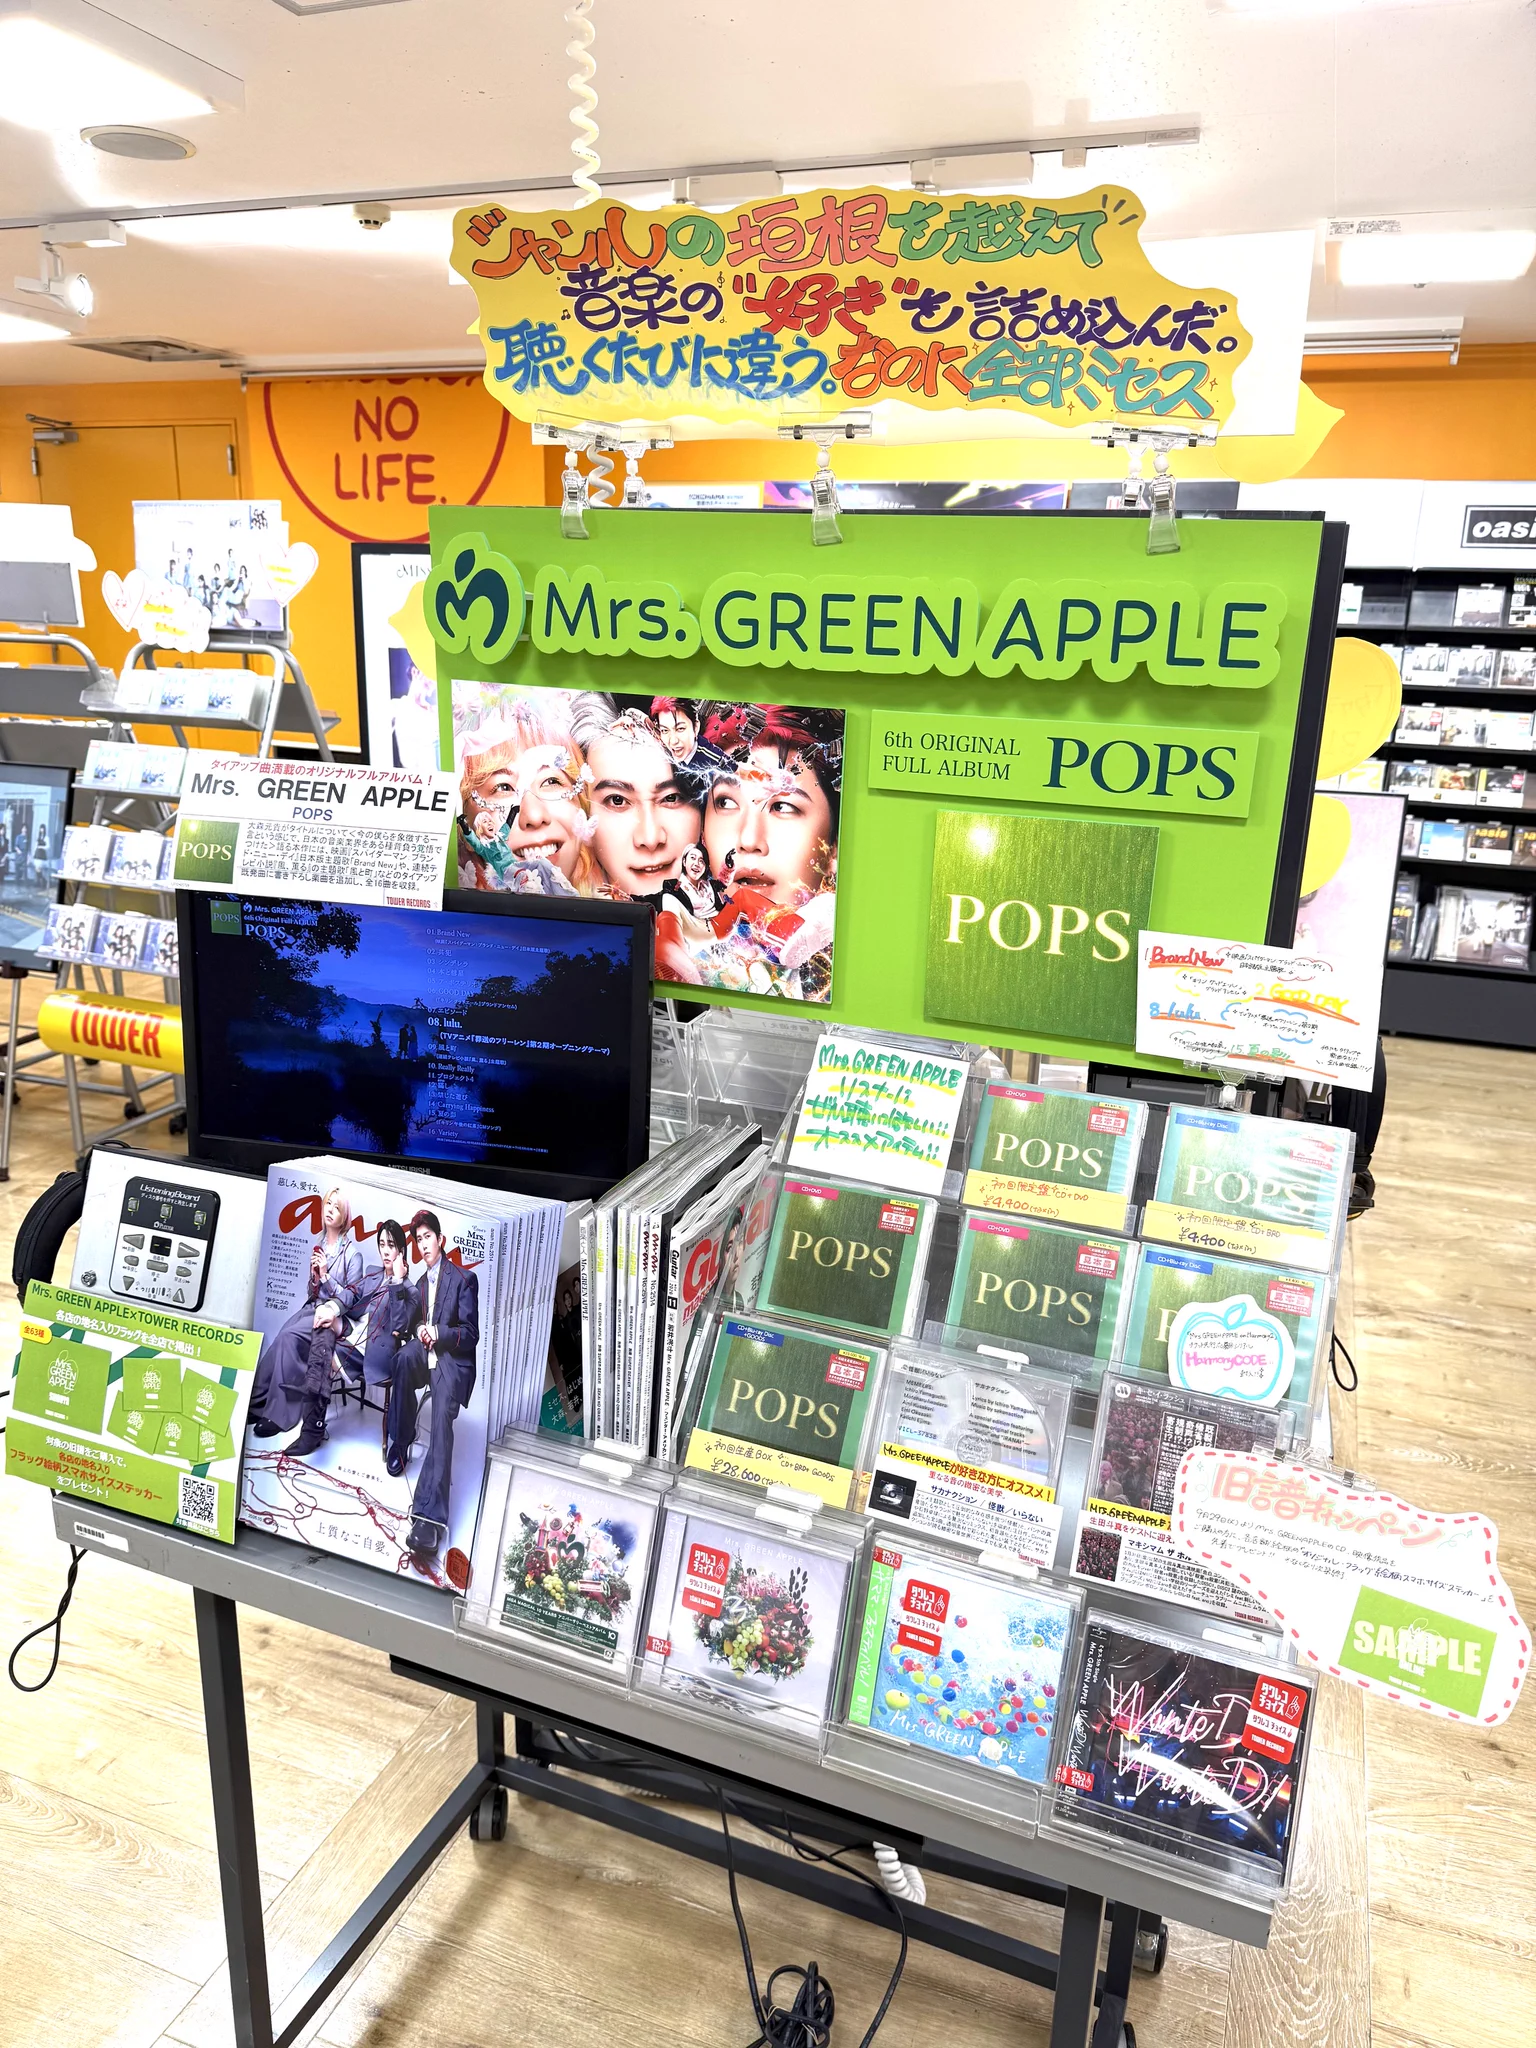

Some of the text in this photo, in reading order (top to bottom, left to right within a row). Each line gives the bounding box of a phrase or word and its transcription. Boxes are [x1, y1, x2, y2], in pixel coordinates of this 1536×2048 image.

[466, 194, 1108, 279] ジャンルの垣根を越えて
[354, 396, 419, 442] NO
[334, 453, 447, 504] LIFE.
[544, 582, 1268, 669] Mrs. GREEN APPLE
[211, 759, 433, 786] タイアップ曲満載のオリジナルフルアルバム!
[882, 755, 1010, 781] FULL ALBUM
[884, 730, 1238, 801] 6th ORIGINAL POPS
[191, 772, 450, 812] Mrs. GREEN APPLE
[292, 806, 333, 821] POPS
[180, 841, 233, 861] POPS
[255, 905, 270, 913] Mrs.
[271, 906, 295, 915] GREEN
[386, 896, 431, 909] TOWER RECORDS
[213, 912, 240, 924] POPS
[255, 915, 280, 924] Original
[944, 893, 1131, 963] POPS
[244, 923, 287, 939] POPS
[456, 930, 471, 938] New
[427, 1017, 462, 1028] 08. lulu.
[437, 1064, 474, 1075] Really Really
[438, 1129, 459, 1139] Variety
[992, 1132, 1103, 1179] POPS
[1183, 1164, 1309, 1214] POPS
[983, 1194, 1029, 1211] ¥4,400
[453, 1236, 486, 1250] GREEN
[467, 1230, 486, 1241] Mrs.
[1178, 1227, 1226, 1248] ¥4,400
[786, 1229, 893, 1279] POPS
[671, 1249, 680, 1281] Guitar
[973, 1270, 1093, 1326] POPS
[32, 1284, 52, 1299] Mrs.
[56, 1292, 91, 1309] GREEN
[182, 1321, 245, 1346] RECORDS
[24, 1325, 45, 1339] 全63種
[49, 1367, 77, 1381] GREEN
[55, 1358, 73, 1371] Mrs.
[48, 1376, 75, 1392] APPLE
[974, 1382, 1011, 1395] サカナクション
[919, 1390, 946, 1400] Yamaguchi
[971, 1401, 985, 1410] Music
[972, 1394, 987, 1404] Lyrics
[1010, 1404, 1039, 1416] Yamaguchi
[725, 1378, 840, 1439] POPS
[974, 1414, 1034, 1435] special edition featuring
[58, 1451, 111, 1475] 各店の地名入り
[711, 1457, 761, 1483] ¥28,600
[10, 1449, 163, 1501] フラッグ絵柄スマホサイズステッカー
[56, 1475, 110, 1500] をプレゼント!
[931, 1485, 978, 1505] サカナクション
[1213, 1464, 1443, 1548] 旧譜キャンペーン
[694, 1550, 717, 1566] タワレコ
[724, 1536, 804, 1565] Mrs. GREEN APPLE
[1128, 1539, 1175, 1557] マキシマム ザ
[692, 1561, 714, 1578] チョイス
[912, 1585, 935, 1602] タワレコ
[910, 1597, 932, 1614] チョイス
[906, 1615, 921, 1626] タワレコ
[1353, 1620, 1482, 1677] SAMPLE
[1085, 1657, 1095, 1681] GREEN
[1079, 1681, 1090, 1705] APPLE
[1261, 1682, 1288, 1703] タワレコ
[1259, 1695, 1285, 1716] チョイス
[924, 1721, 976, 1749] GREEN
[1252, 1714, 1287, 1737] タワレコ チョイス
